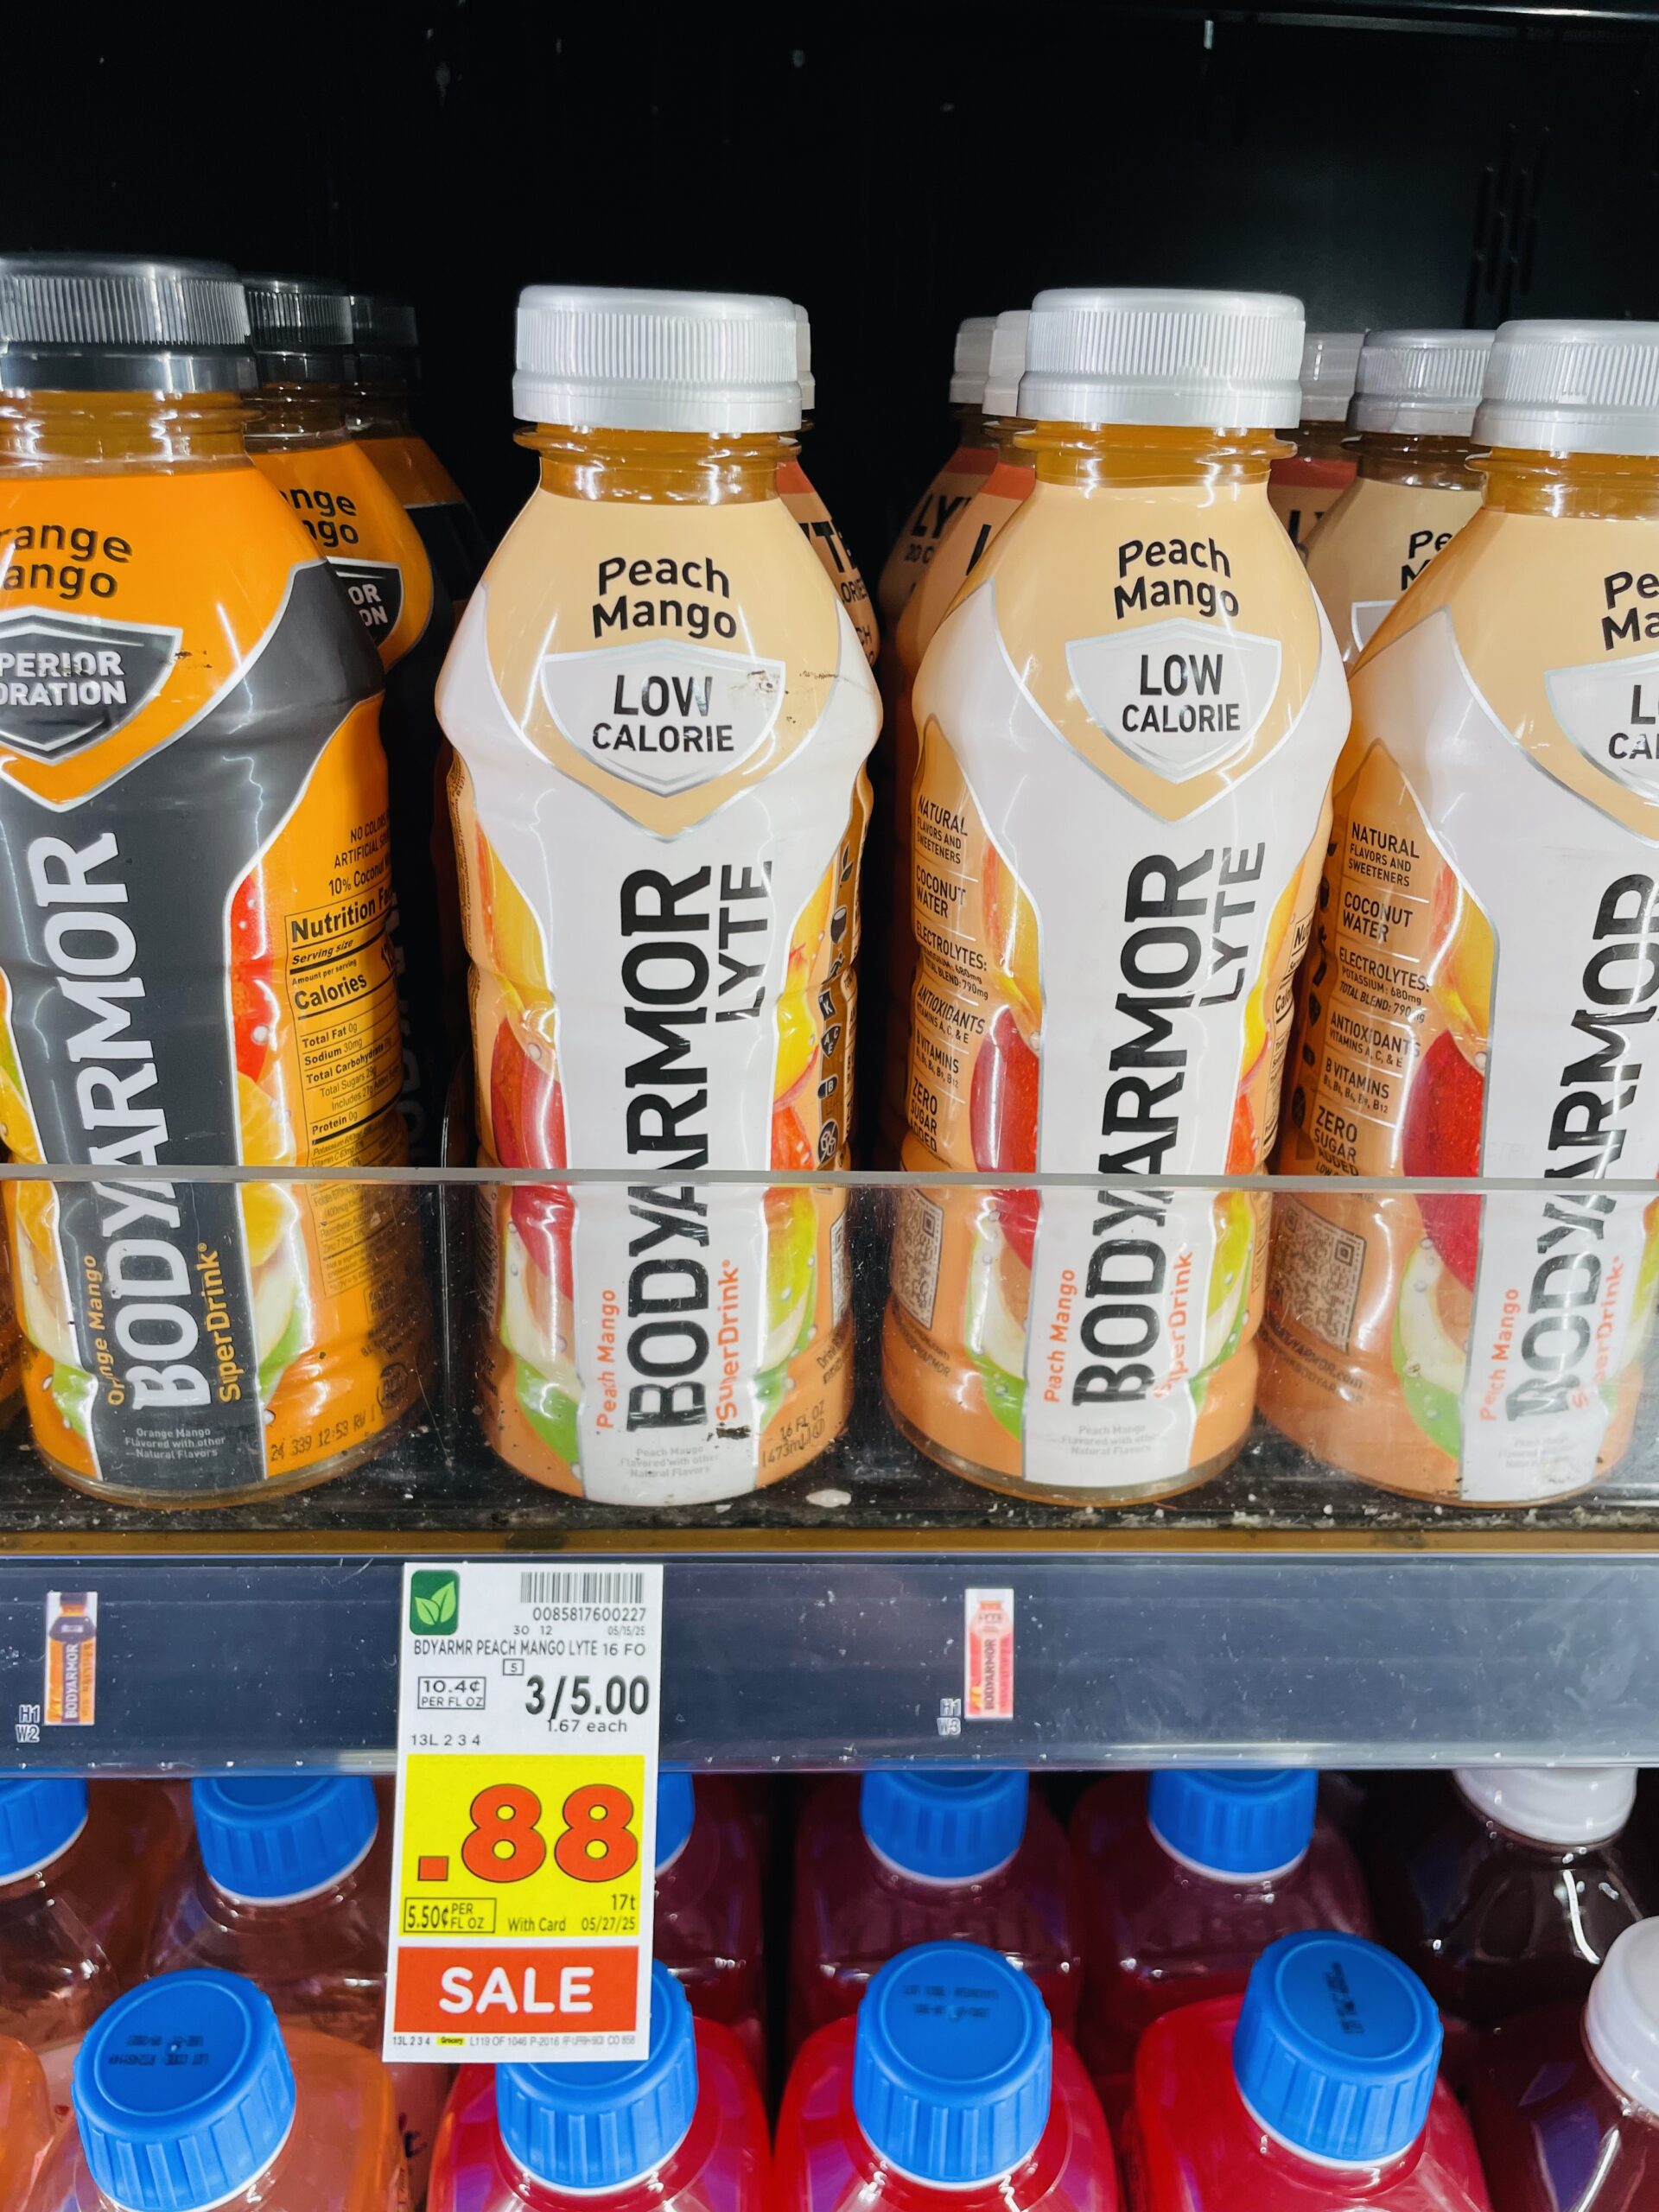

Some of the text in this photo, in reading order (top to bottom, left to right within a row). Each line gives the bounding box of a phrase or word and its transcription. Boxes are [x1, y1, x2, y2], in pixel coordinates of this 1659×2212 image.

[280, 488, 357, 518] nge
[0, 524, 132, 563] ange
[1118, 537, 1231, 578] Peach
[598, 556, 730, 599] Peach
[1114, 577, 1239, 620] Mango
[592, 594, 737, 639] Mango
[1140, 653, 1224, 696] LOW
[613, 675, 713, 717] LOW
[1122, 703, 1241, 734] CALORIE
[592, 722, 734, 753] CALORIE
[918, 795, 968, 836] NATURAL
[918, 817, 962, 849] FLAVORS AND
[350, 826, 362, 843] NO
[918, 833, 961, 864] SWEETENERS
[1351, 822, 1420, 859] NATURAL
[334, 841, 378, 868] ARTIFICIAL
[1350, 843, 1412, 872] FLAVORS AND
[328, 876, 352, 897] 10%
[916, 865, 966, 906] COCONUT
[1348, 858, 1410, 887] SWEETENERS
[916, 883, 948, 918] WATER
[1344, 891, 1414, 927] COCONUT
[291, 899, 376, 943] Nutrition
[1198, 842, 1266, 1007] LYTE
[1343, 910, 1389, 942] WATER
[292, 938, 353, 965] Serving size
[715, 861, 772, 1023] LYTE
[917, 920, 988, 972] ELECTROLYTES:
[292, 958, 357, 985] Amount per serving
[939, 966, 988, 1001] BLEND: 790mg
[1339, 947, 1430, 993] ELECTROLYTES:
[1342, 966, 1421, 1006] POTASSIUM: 680mg
[294, 974, 367, 1010] Calories
[1340, 981, 1392, 1013] TOTAL BLEND:
[918, 985, 986, 1035] ANTIOXIDANTS
[302, 1023, 358, 1048] Total Fat 0g
[304, 1038, 363, 1066] Sodium 30mg
[956, 1029, 962, 1041] &
[963, 1033, 969, 1044] E
[1330, 1029, 1363, 1053] VITAMINS
[1375, 1050, 1384, 1065] C,
[1386, 1054, 1394, 1065] &
[1396, 1057, 1403, 1068] E
[1331, 1012, 1421, 1058] ANTIOXIDANTS
[306, 1043, 385, 1084] Total Carbohydrate
[920, 1035, 959, 1074] VITAMINS
[320, 1072, 365, 1098] Total Sugars
[1325, 1058, 1389, 1099] B VITAMINS
[332, 1091, 361, 1111] Includes
[912, 1077, 938, 1116] ZERO
[1373, 1100, 1389, 1114] B12
[27, 832, 212, 1410] BODYARMOR
[312, 1110, 358, 1135] Protein 0g
[911, 1100, 938, 1135] SUGAR
[1072, 849, 1214, 1407] BODYARMOR
[1316, 1106, 1357, 1143] ZERO
[620, 865, 712, 1432] BODYARMOR
[1314, 1128, 1357, 1163] SUGAR
[84, 1255, 104, 1330] Mango
[1054, 1269, 1077, 1344] Mango
[595, 1288, 620, 1364] Mango
[1491, 1288, 1521, 1362] Mango
[125, 1436, 226, 1448] Flavored with other
[137, 1427, 211, 1440] Orange Mango
[136, 1448, 218, 1459] Natural Flavors
[636, 1447, 667, 1456] Peach
[513, 1624, 646, 1637] 30 12 05/15/25
[532, 1607, 646, 1622] 0085817600227
[414, 1639, 645, 1656] BDYARMR PEACH MANGO LYTE 16 FO
[65, 1643, 79, 1719] BODYARMOR
[422, 1679, 480, 1694] 10.4¢
[524, 1675, 650, 1719] 3/5.00
[422, 1696, 485, 1707] PER FL OZ
[15, 1724, 41, 1743] W2
[411, 1735, 481, 1746] 13L 2 3 4
[547, 1719, 628, 1732] 1.67 each
[417, 1783, 639, 1884] .88
[407, 1903, 474, 1929] 5.50¢ PER
[611, 1894, 636, 1910] 17t
[450, 1917, 485, 1929] FL OZ
[508, 1917, 636, 1932] With Card 05/27/25
[439, 1967, 594, 2014] SALE
[393, 2036, 408, 2046] 13L
[492, 2036, 505, 2047] OF
